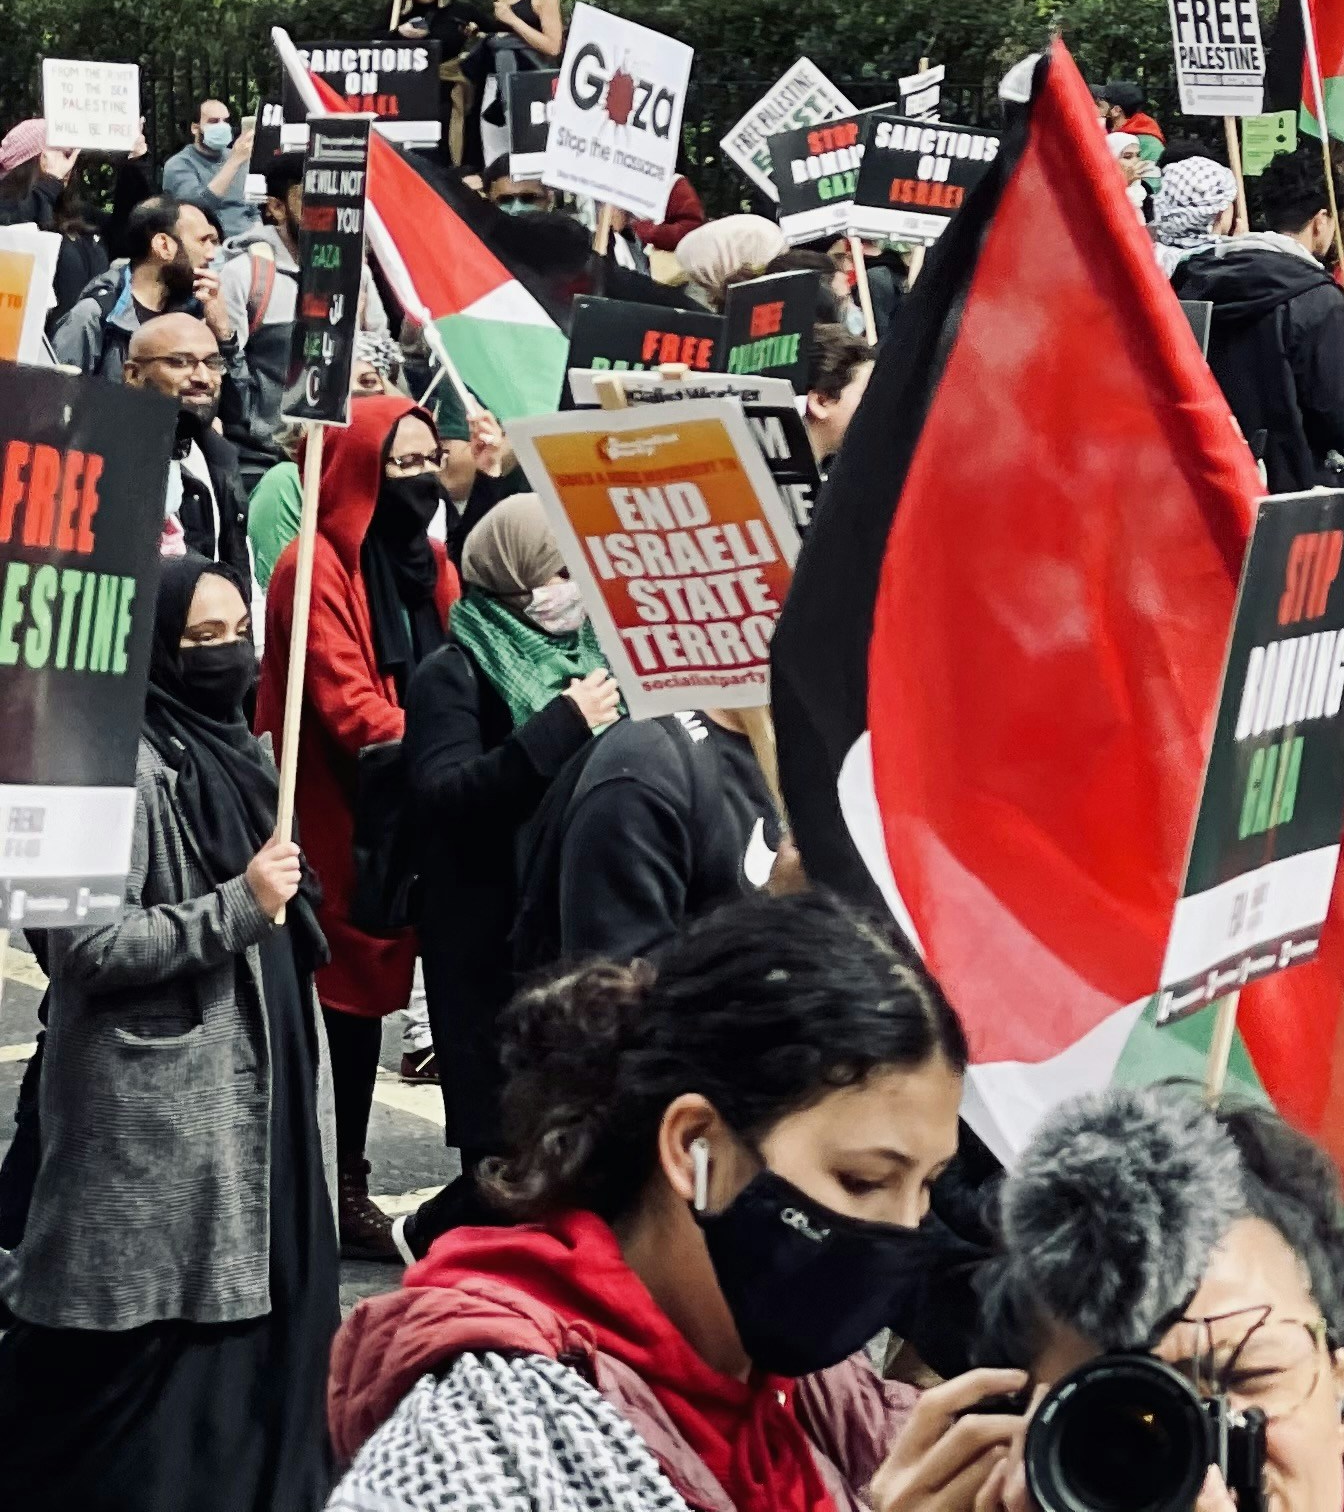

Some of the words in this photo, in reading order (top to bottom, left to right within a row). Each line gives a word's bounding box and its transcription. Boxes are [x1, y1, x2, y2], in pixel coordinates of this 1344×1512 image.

[297, 48, 429, 72] SANCTIONS
[1179, 45, 1260, 70] PALESTINE
[61, 83, 73, 93] TO
[85, 83, 100, 94] THE
[345, 71, 378, 95] ON
[570, 43, 675, 140] Gza
[62, 98, 127, 114] PALESTINE
[55, 121, 79, 134] WILL
[557, 126, 586, 158] Stop
[807, 122, 859, 155] STOP
[875, 122, 1000, 162] SANCTIONS
[917, 155, 950, 182] ON
[337, 208, 360, 233] YOU
[641, 330, 714, 369] FREE
[0, 440, 104, 554] FREE
[607, 482, 711, 530] END
[585, 519, 777, 580] ISRAELI
[627, 568, 779, 622] STATE
[620, 615, 776, 671] TERRO
